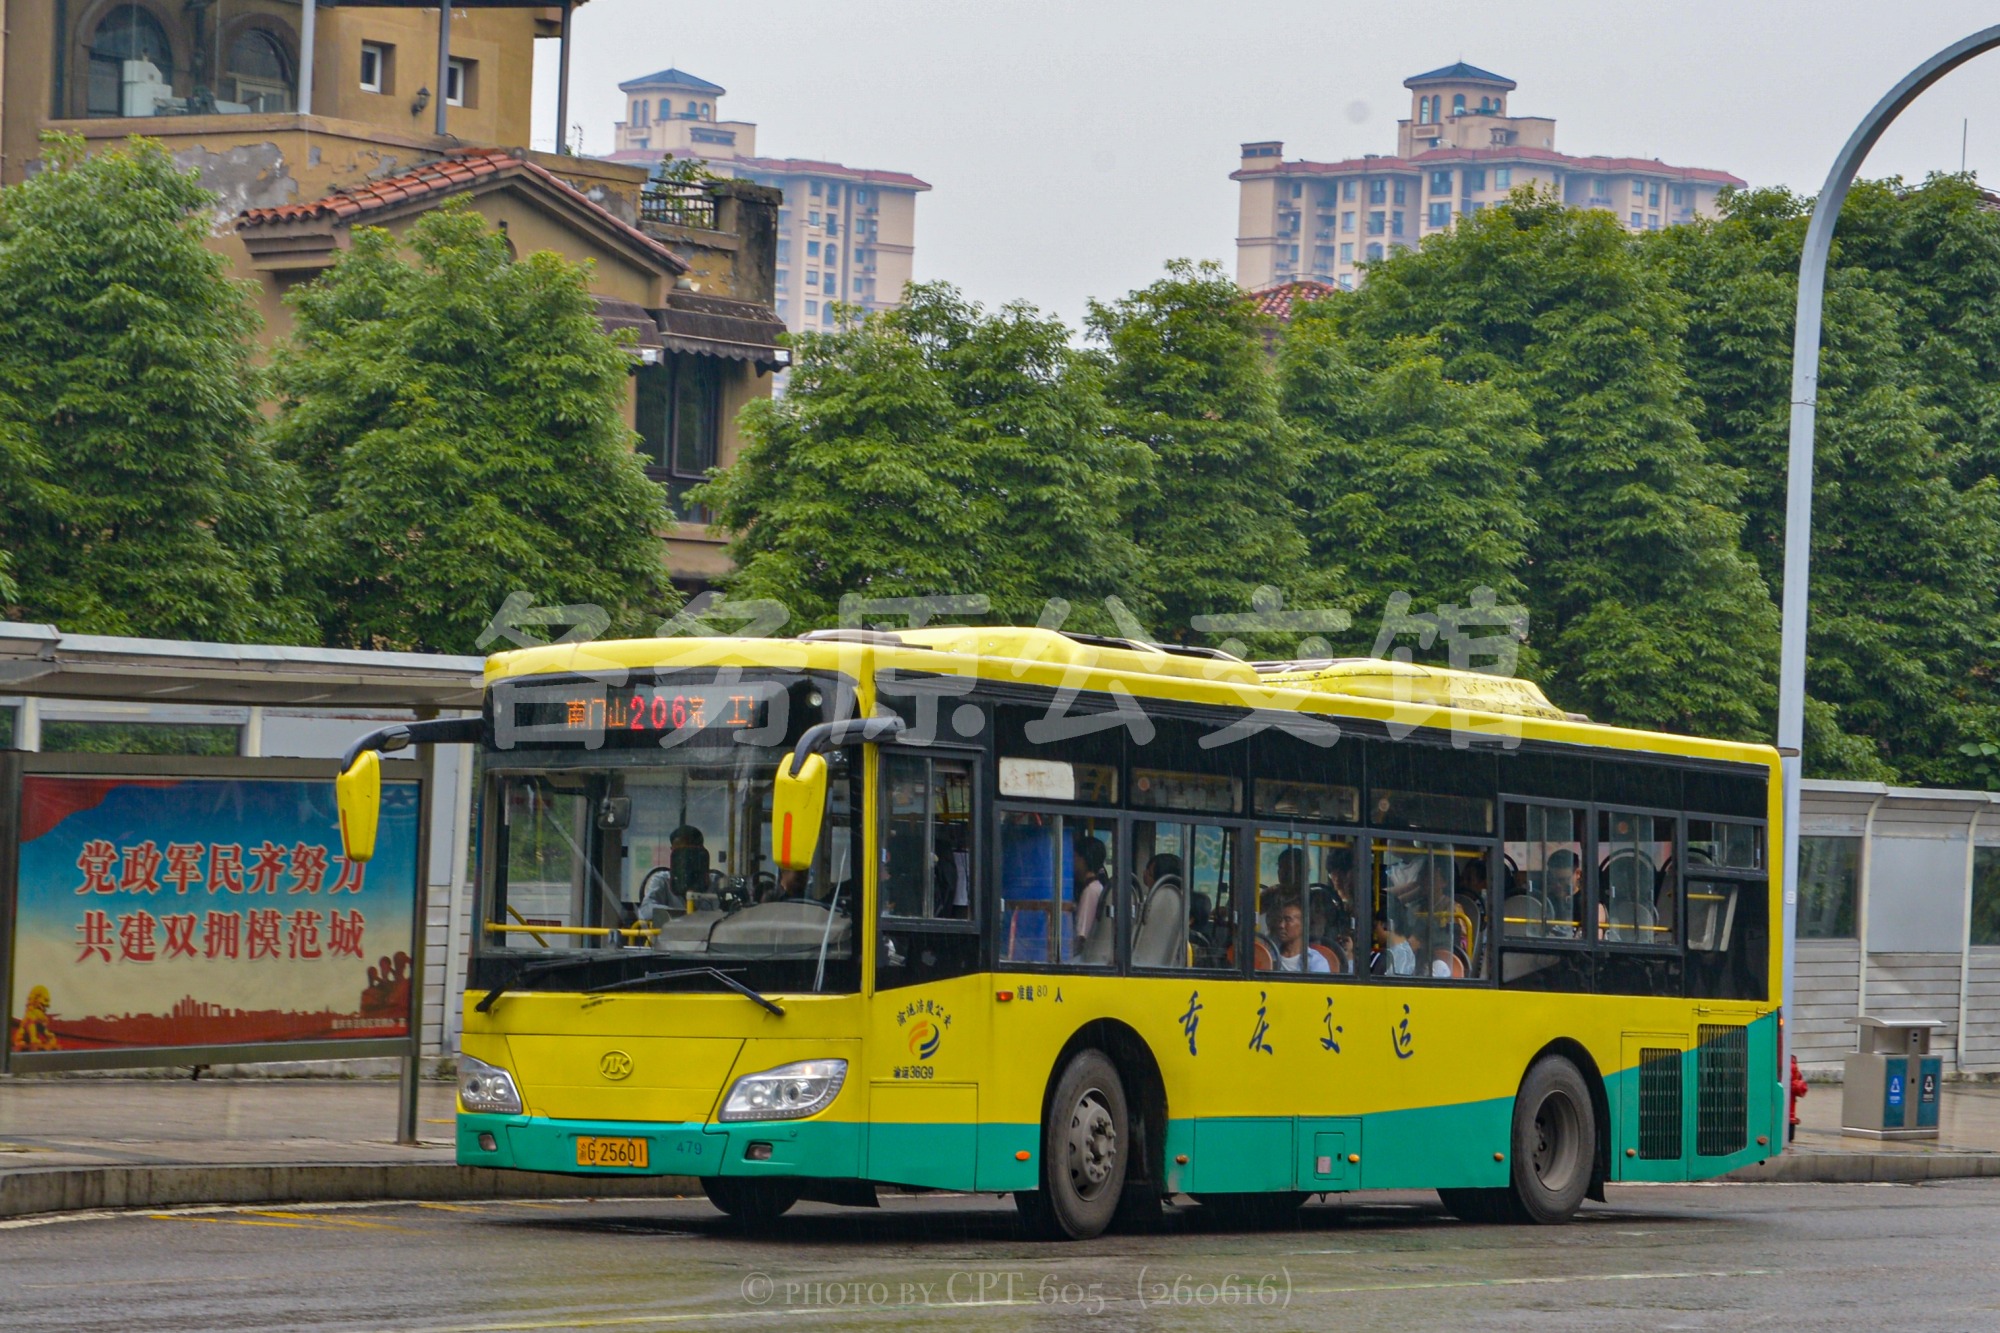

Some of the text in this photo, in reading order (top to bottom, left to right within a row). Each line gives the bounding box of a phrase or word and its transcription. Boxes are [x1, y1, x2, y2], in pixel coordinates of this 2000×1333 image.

[630, 695, 687, 730] 206
[75, 838, 368, 895] 党政军民齐努力
[75, 908, 366, 963] 共建双拥模范城
[1178, 989, 1415, 1060] 重庆交运
[676, 1140, 703, 1155] 479
